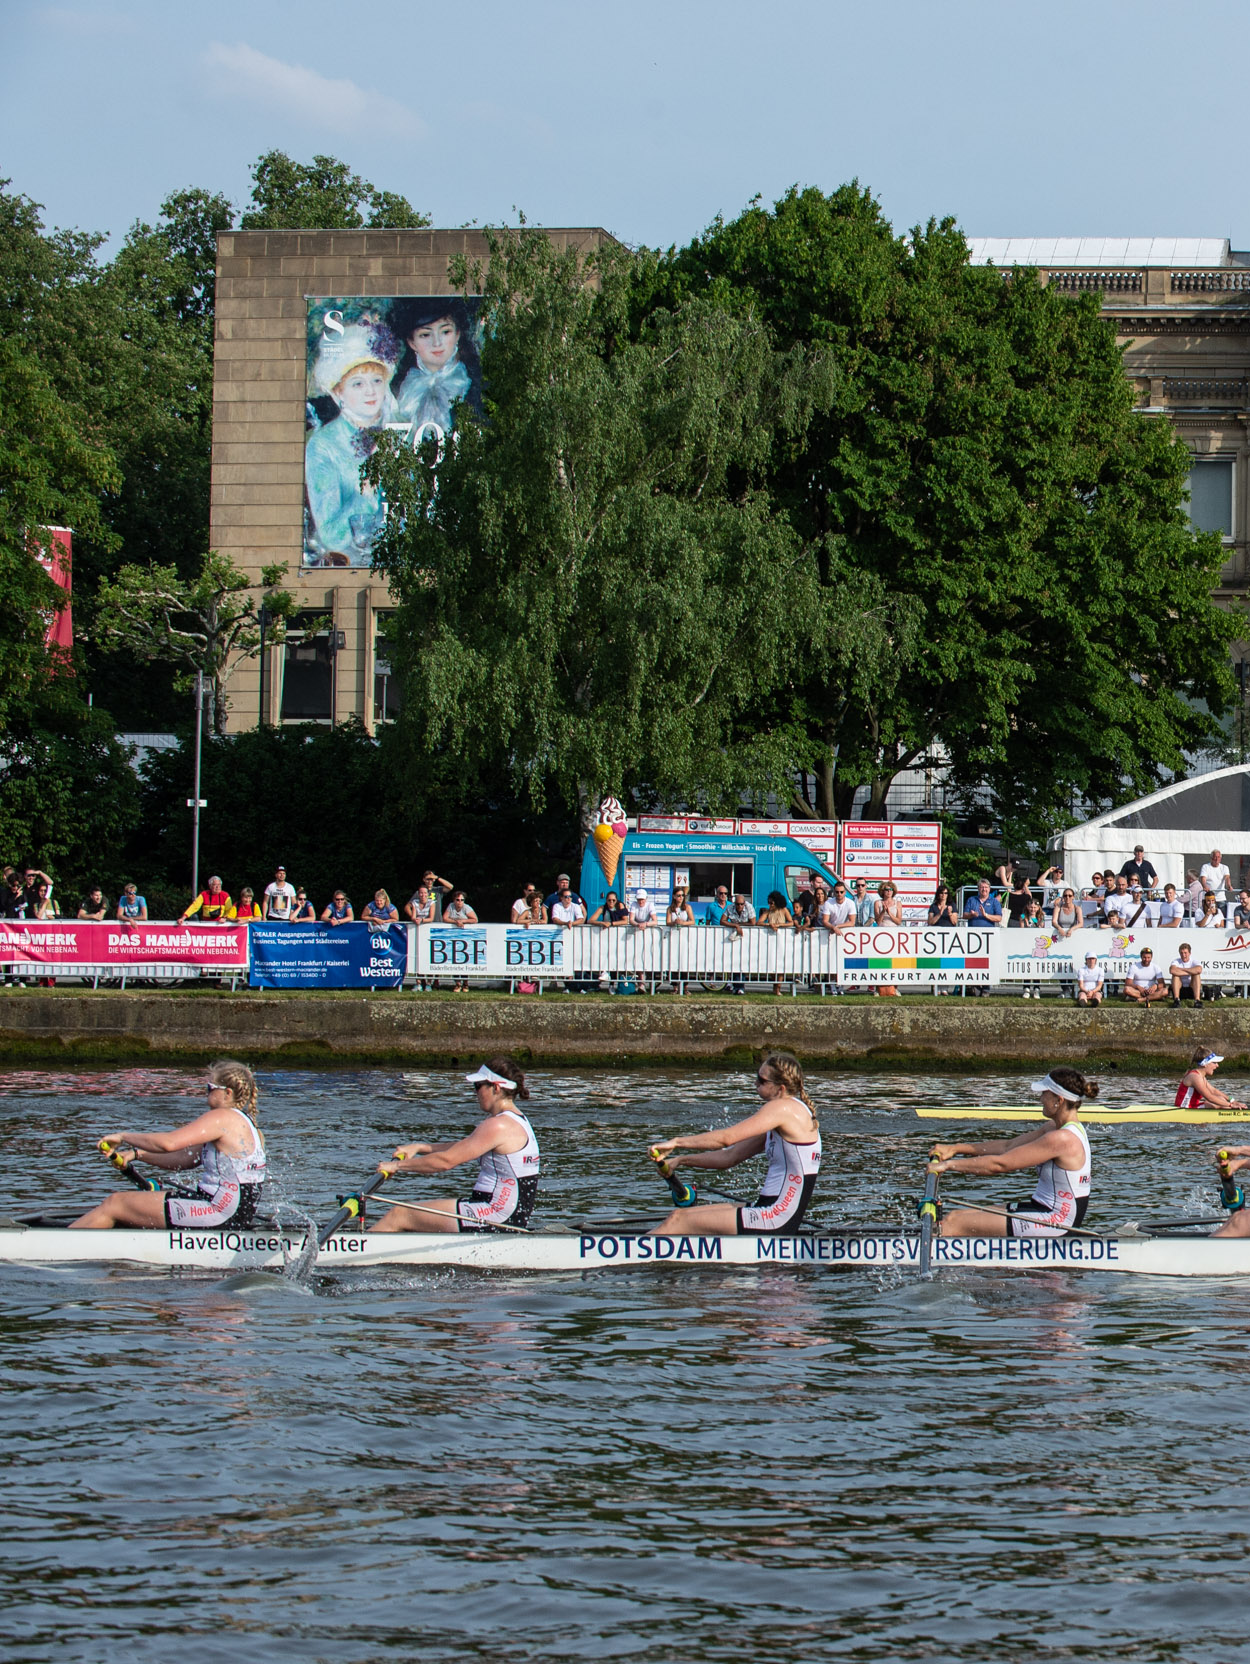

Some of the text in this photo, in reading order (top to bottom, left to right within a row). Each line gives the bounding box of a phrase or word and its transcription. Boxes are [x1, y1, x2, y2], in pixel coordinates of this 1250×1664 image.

[324, 311, 344, 343] S
[849, 840, 863, 848] BBF
[872, 840, 885, 848] BBF
[108, 930, 238, 947] DAS HANDWERK
[372, 937, 391, 949] BW
[843, 932, 994, 954] SPORTSTADT
[120, 947, 190, 955] WIRTSCHAFTSMACHT.
[428, 939, 487, 964] BBF
[504, 940, 564, 965] BBF
[370, 957, 393, 967] Best
[1007, 962, 1074, 973] TITUS THERMEN
[844, 972, 990, 981] FRANKFURT AM MAIN
[788, 1174, 802, 1184] 8
[1058, 1190, 1073, 1200] 8
[580, 1236, 722, 1259] POTSDAM
[757, 1237, 1119, 1260] MEINEBOOTSVRSICHERUNG.DE
